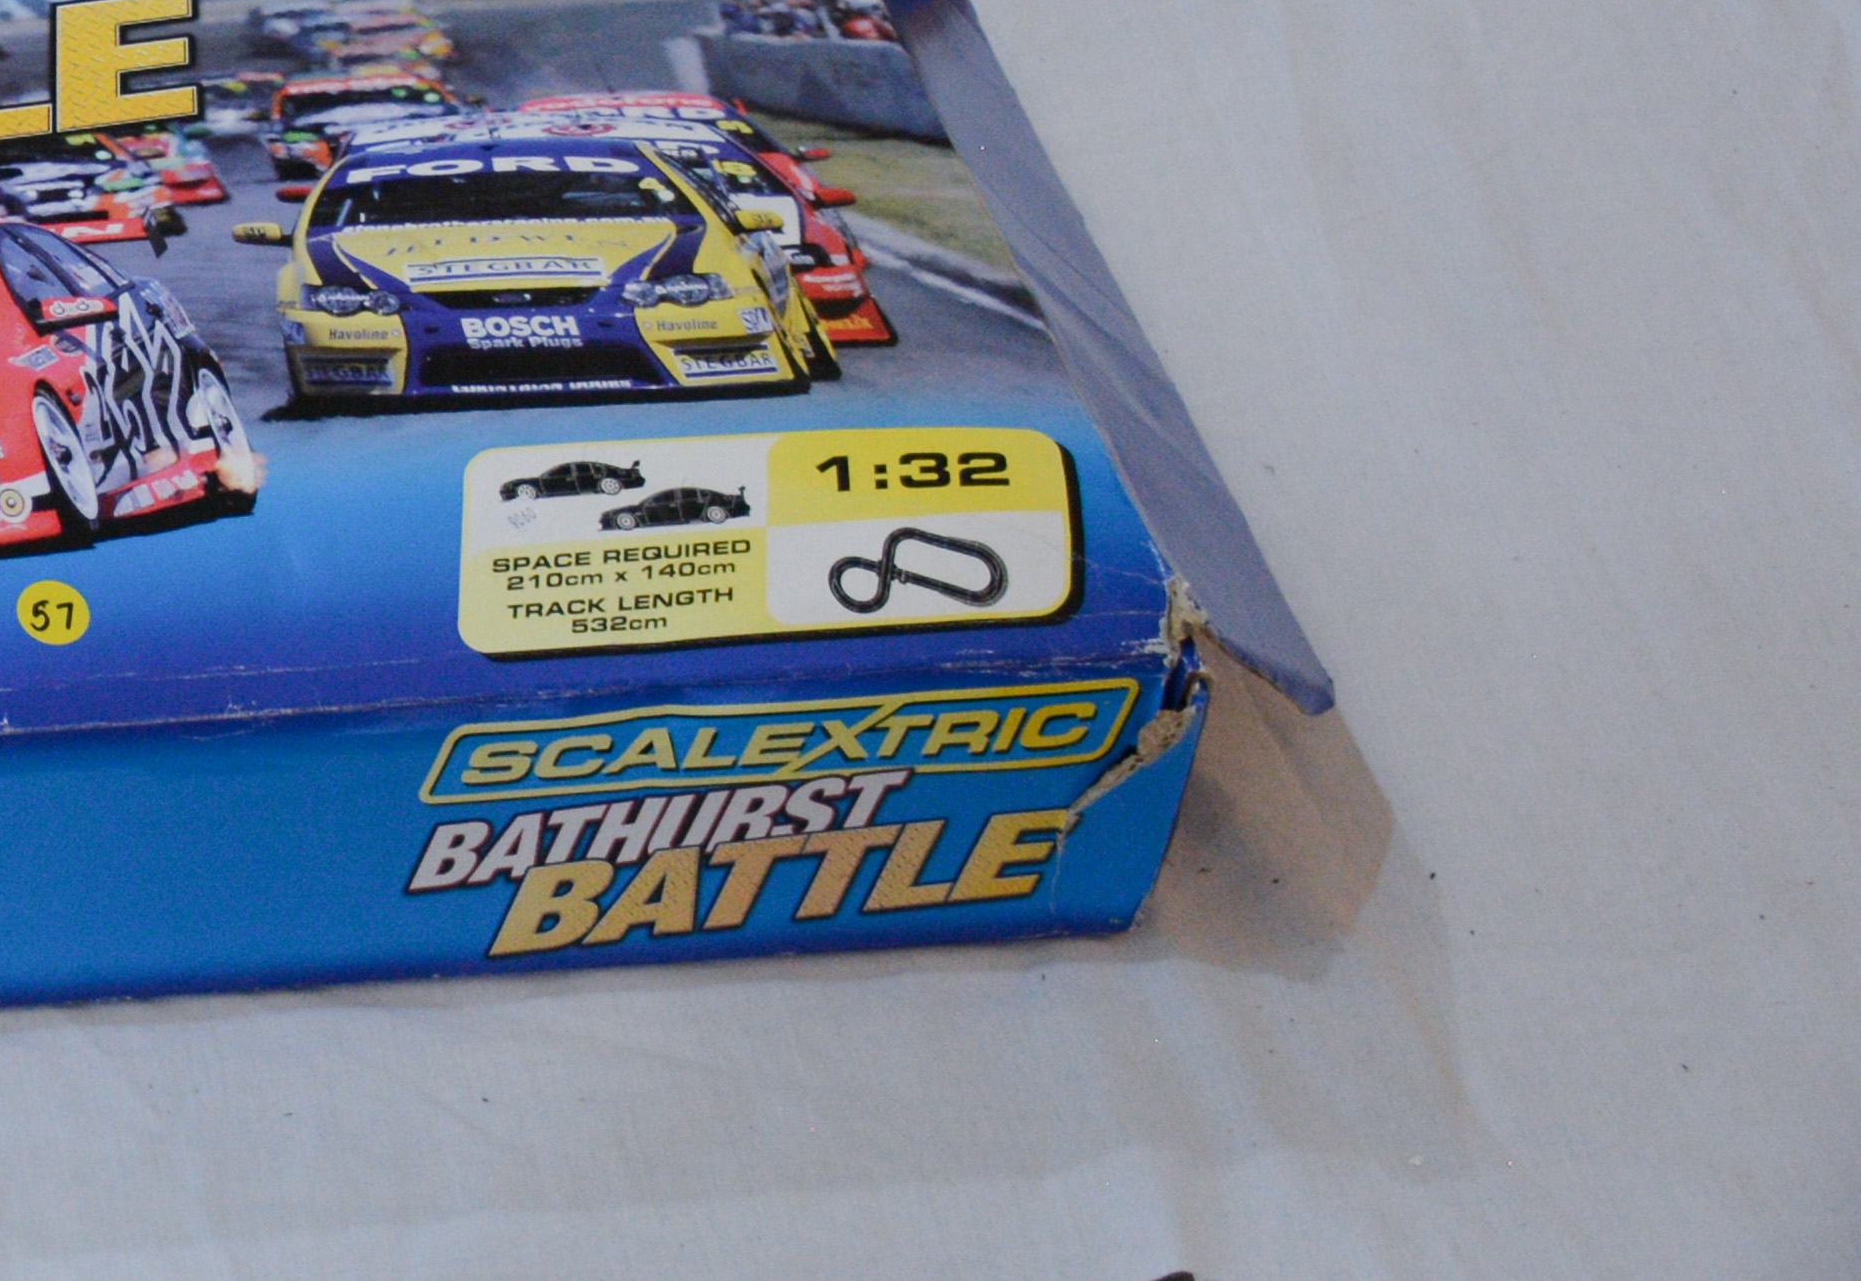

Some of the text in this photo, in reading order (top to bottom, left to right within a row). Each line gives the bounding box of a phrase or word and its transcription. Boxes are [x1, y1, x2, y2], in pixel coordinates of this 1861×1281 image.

[347, 156, 640, 183] FORD
[460, 316, 578, 338] BOSCH
[656, 319, 718, 331] Havoline
[467, 334, 583, 350] Spark Plugs
[816, 451, 1011, 493] 1:32
[492, 539, 752, 575] SPACE REQUIRED
[505, 561, 737, 592] 210cm x 140cm
[30, 600, 74, 632] 57
[508, 588, 734, 621] TRACK LENGTH
[571, 613, 668, 635] 532cm
[461, 702, 1098, 785] SCALEXTRIC
[408, 769, 910, 893] BATHURST
[488, 808, 1080, 957] BATTLE
